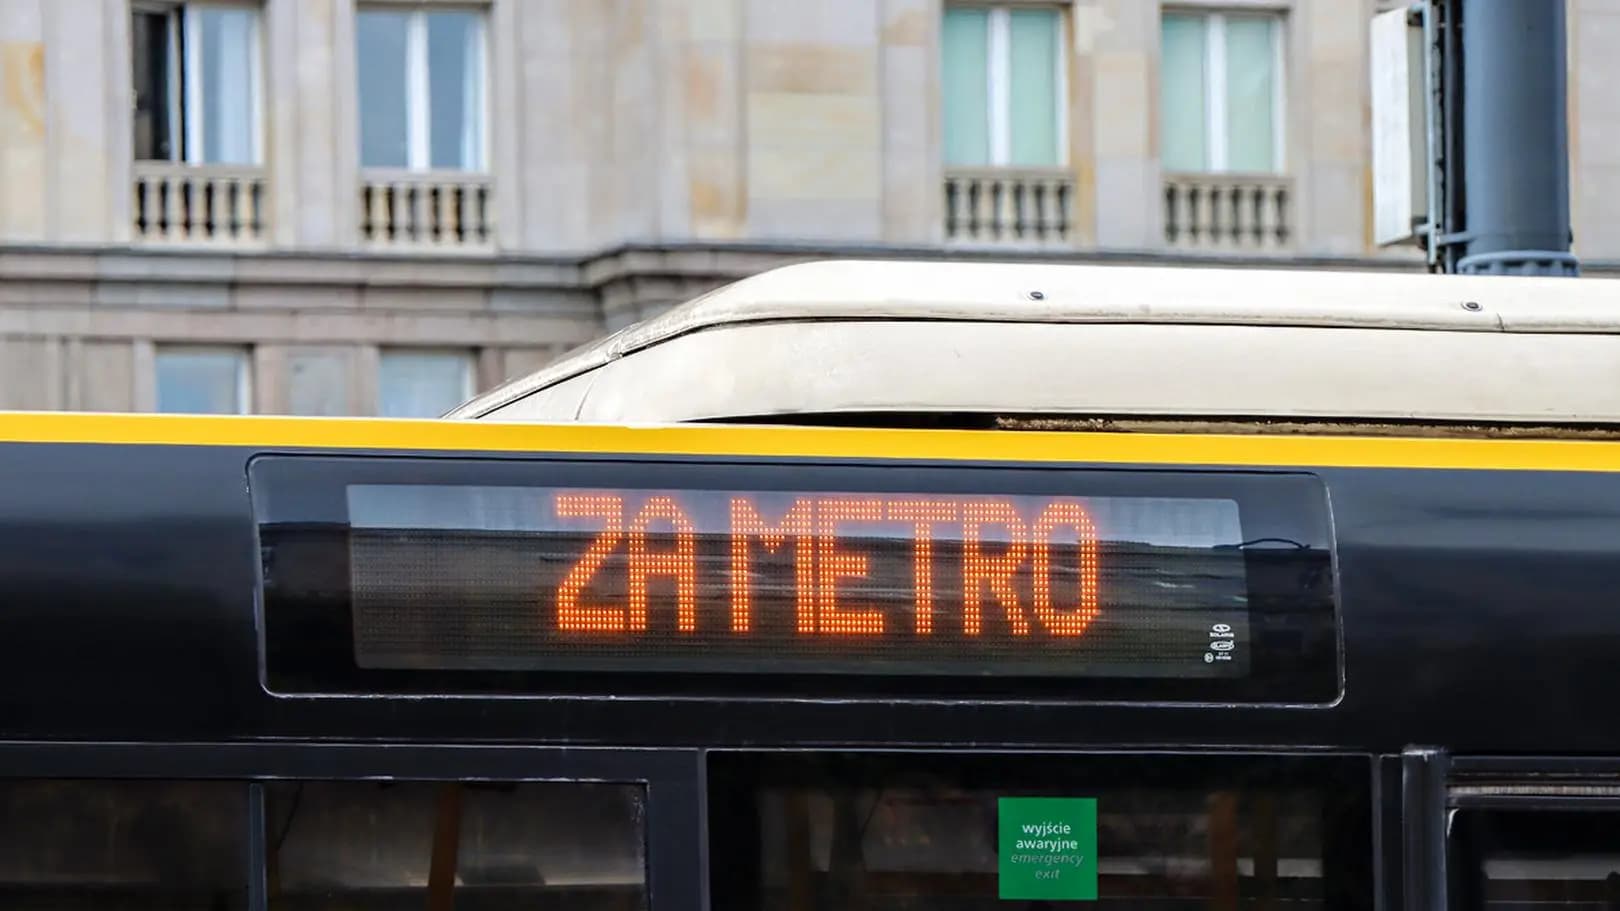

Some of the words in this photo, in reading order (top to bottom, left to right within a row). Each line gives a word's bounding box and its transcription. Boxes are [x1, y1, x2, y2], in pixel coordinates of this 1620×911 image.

[556, 496, 695, 631] ZA
[731, 498, 1098, 635] METRO
[1022, 821, 1071, 837] wyjście
[1016, 838, 1078, 852] awaryjne
[1011, 854, 1084, 866] emergency
[1035, 869, 1060, 879] exit
